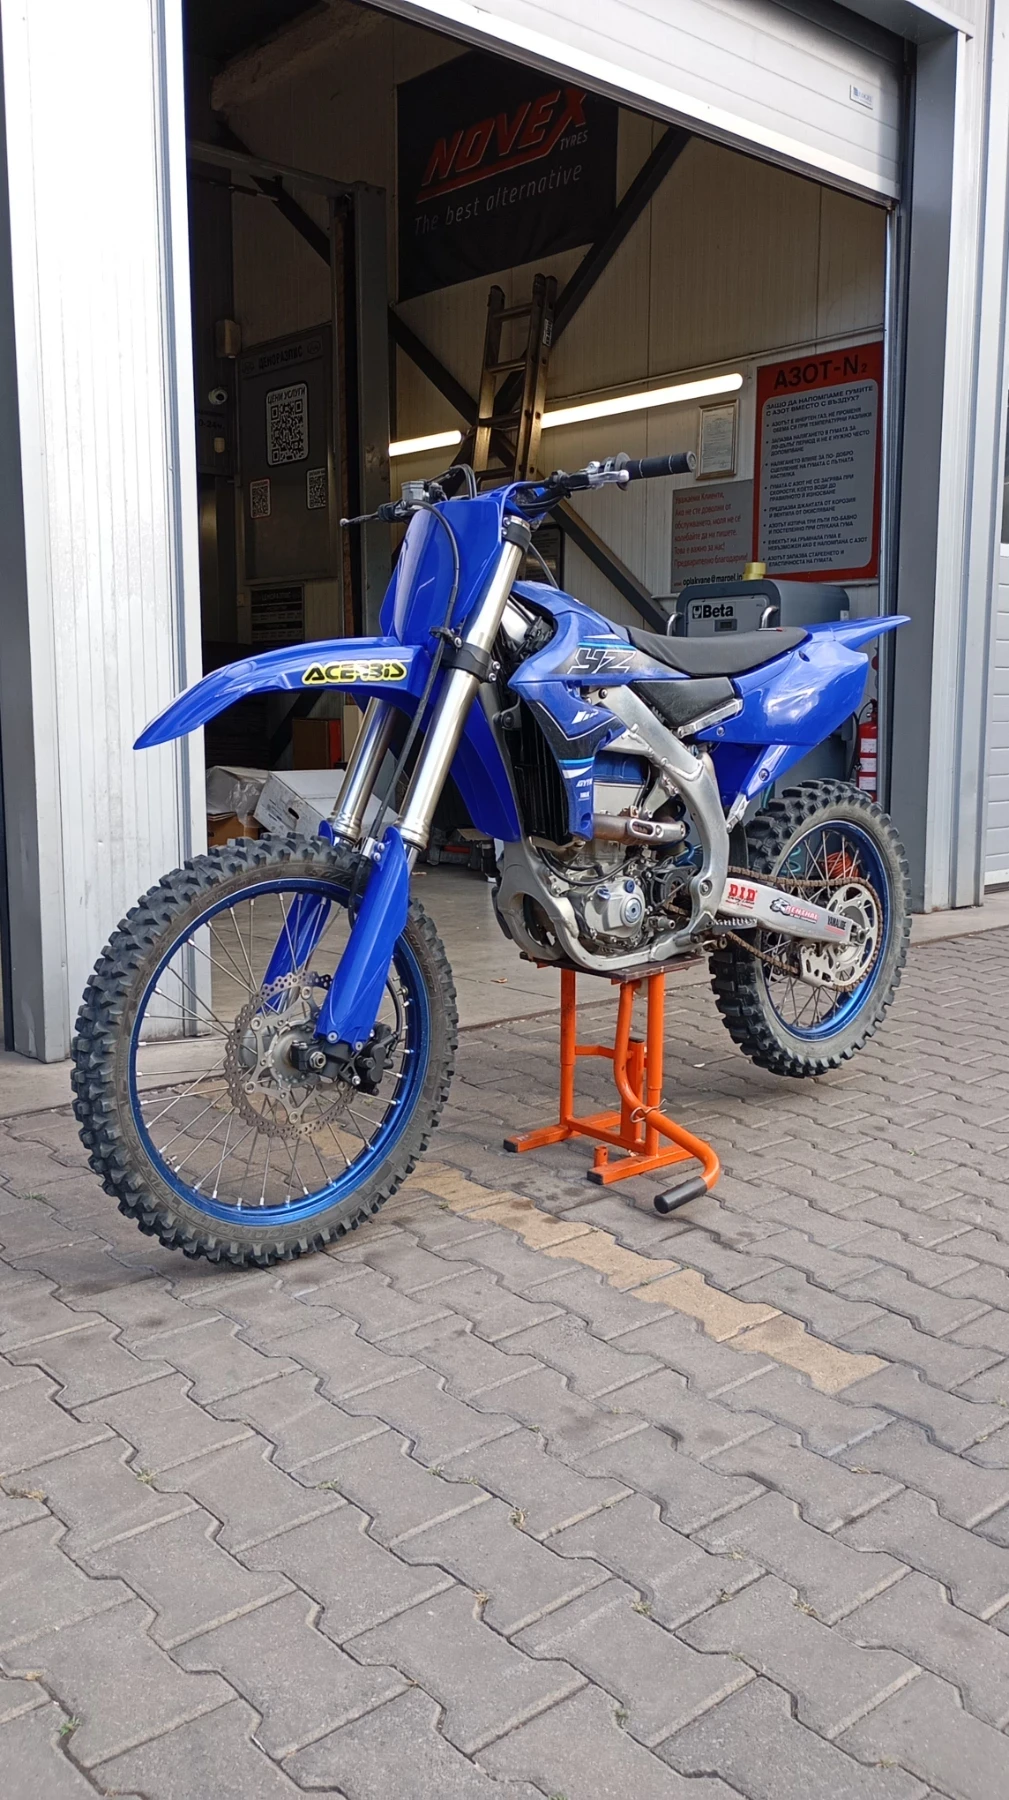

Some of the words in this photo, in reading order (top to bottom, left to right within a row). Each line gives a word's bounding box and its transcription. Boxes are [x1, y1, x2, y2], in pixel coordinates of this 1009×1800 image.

[419, 87, 588, 188] NOVEX
[560, 130, 588, 152] TYRES
[415, 213, 439, 237] The
[445, 198, 480, 226] best
[486, 164, 583, 212] alternative
[258, 345, 303, 371] ЦЕНОРАЗПИС
[267, 391, 285, 405] ЦЕНИ
[284, 386, 305, 402] УСЛУГИ
[767, 402, 786, 410] ЗАЩО
[799, 391, 843, 404] НАПОМПАМЕ
[845, 386, 873, 395] ГУМИТЕ
[772, 408, 789, 416] АЗОТ
[791, 402, 819, 412] ВМЕСТО
[828, 395, 859, 405] ВЪЗДУХ?
[795, 415, 816, 423] ИНЕРТЕН
[809, 416, 847, 427] ТЕМПЕРАТУРНИ
[793, 431, 824, 441] НАЛЯГАНЕТО
[771, 459, 800, 468] НАЛЯГАНЕТО
[676, 509, 684, 517] Ако
[701, 505, 725, 514] доволни
[674, 546, 685, 555] Това
[691, 545, 707, 553] важно
[703, 603, 734, 619] Beta
[567, 648, 637, 675] YZ
[304, 661, 406, 683] ACERBIS
[785, 906, 819, 921] RENTHAL
